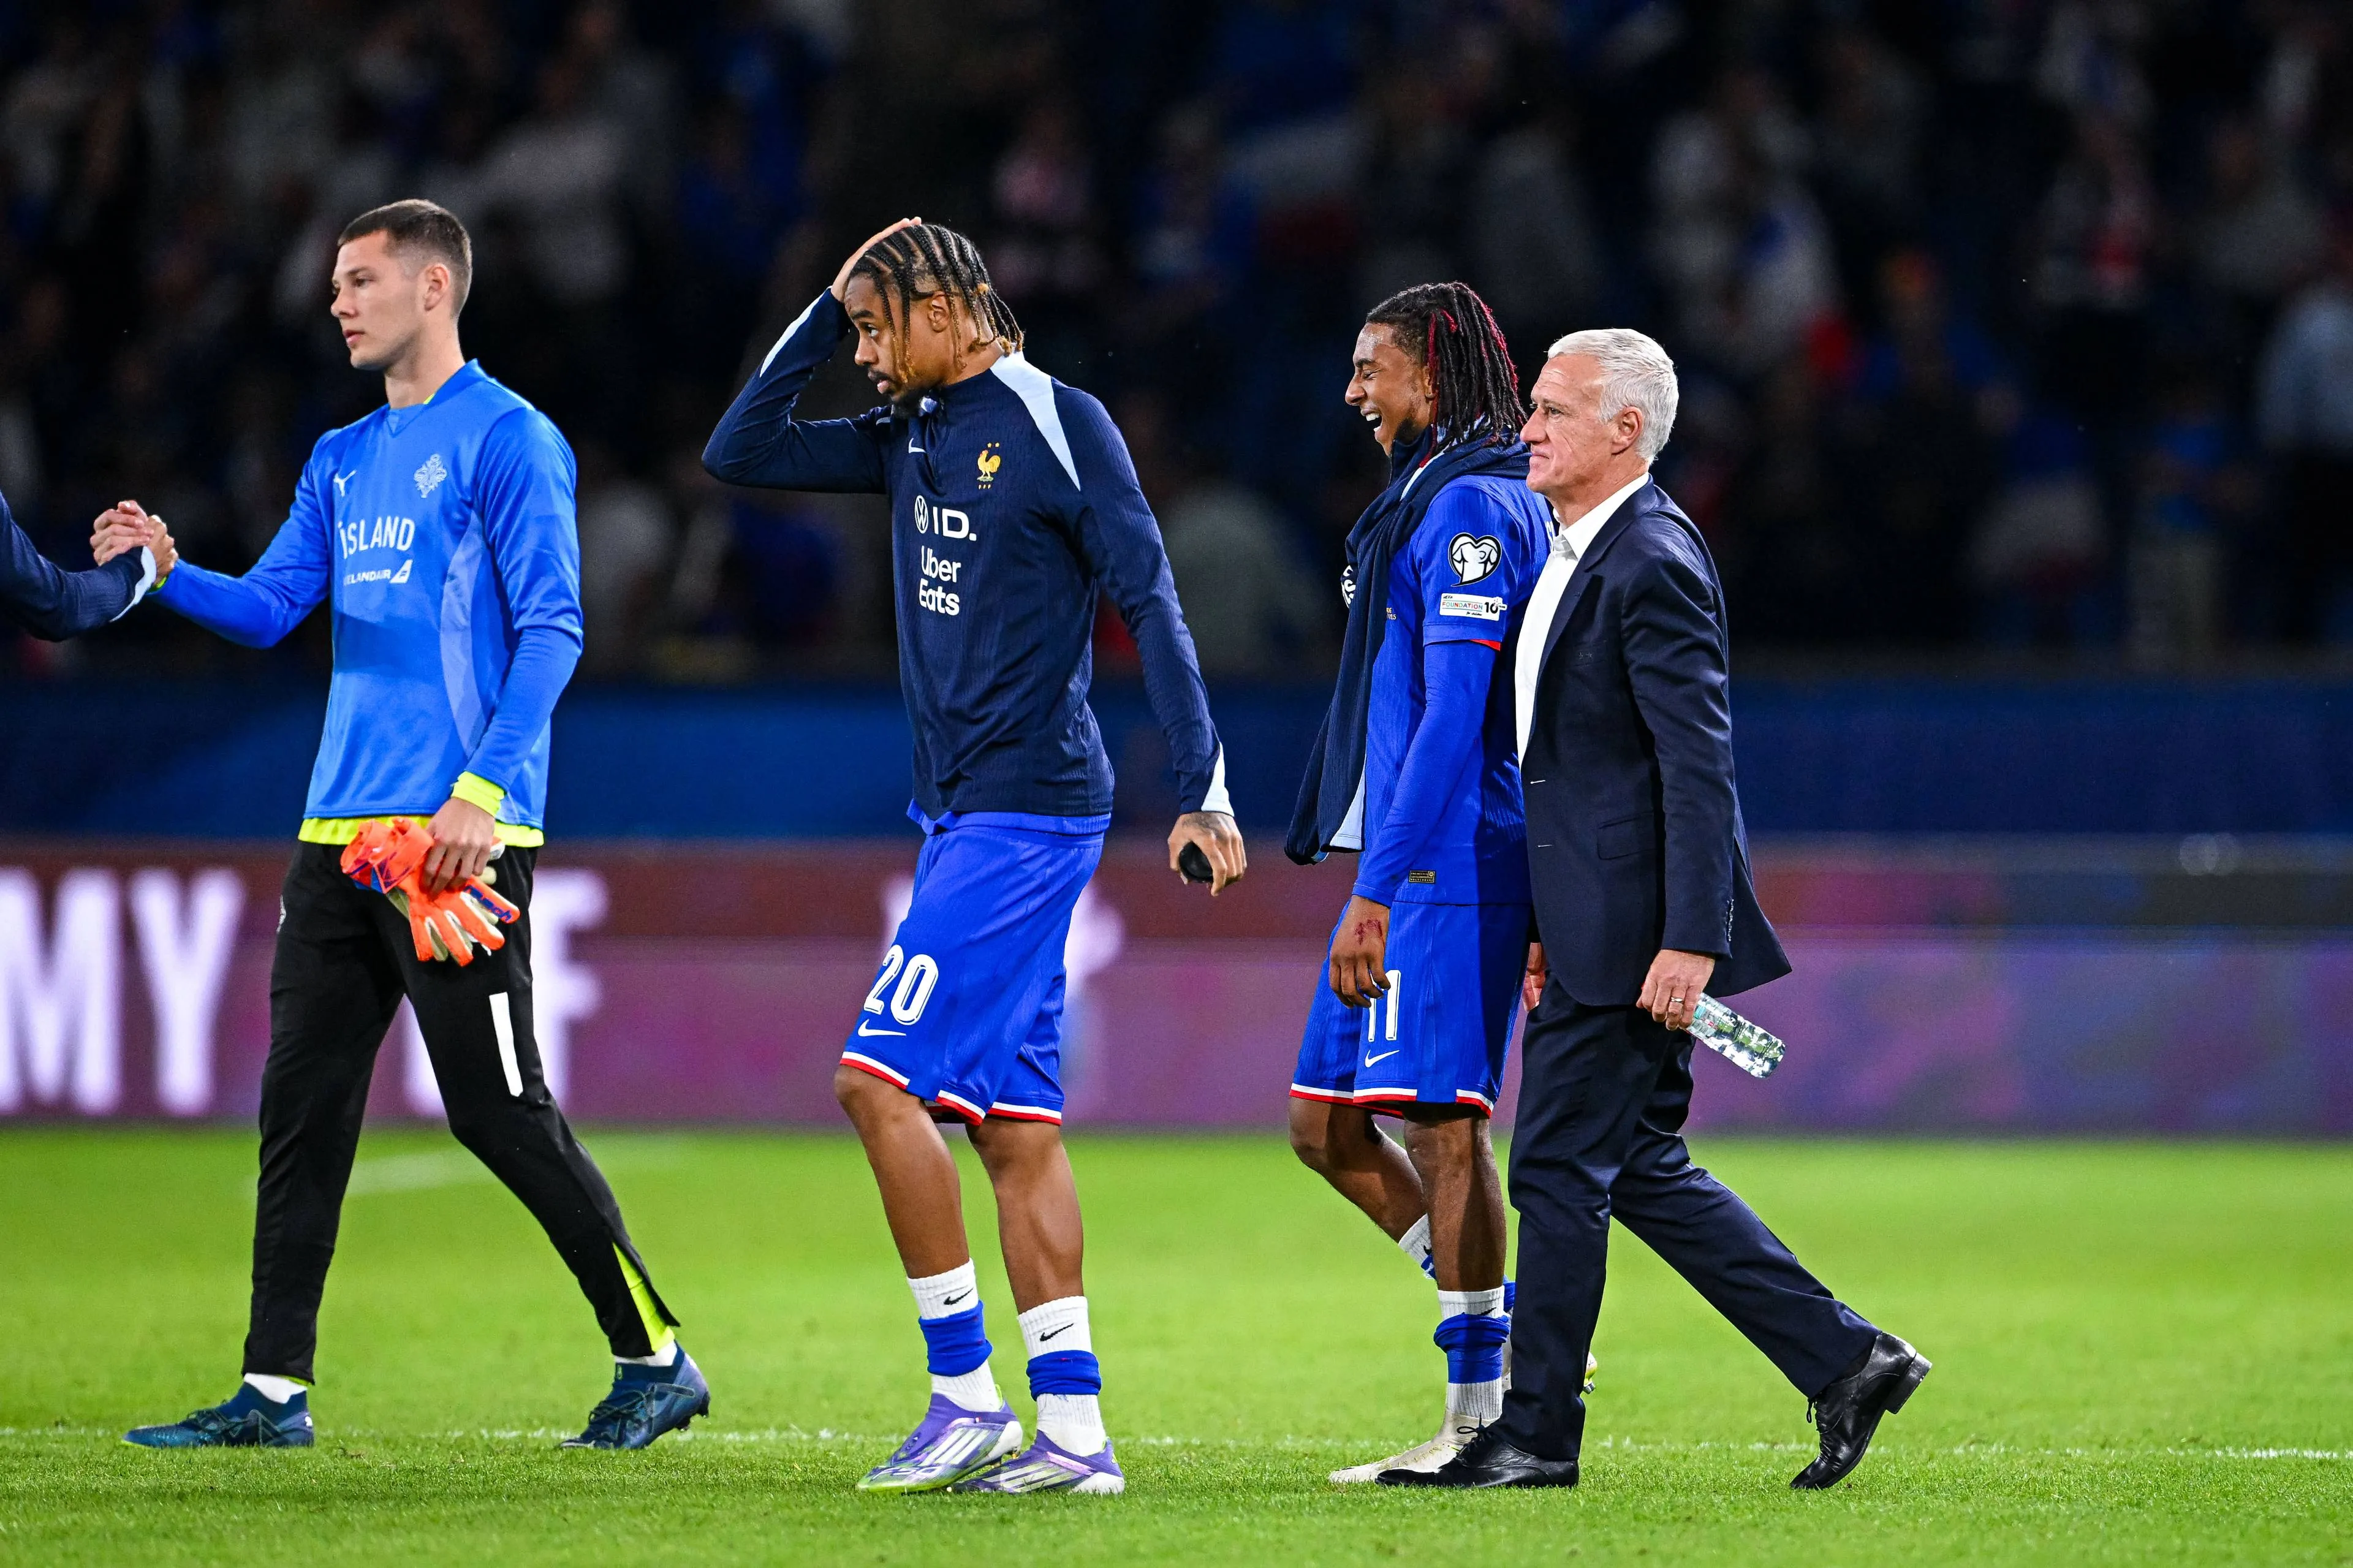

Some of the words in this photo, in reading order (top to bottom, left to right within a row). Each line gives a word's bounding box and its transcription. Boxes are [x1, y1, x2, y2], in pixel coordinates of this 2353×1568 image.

[933, 506, 977, 542] ID.
[921, 545, 961, 582] Uber
[919, 578, 960, 615] Eats
[863, 944, 939, 1026] 20
